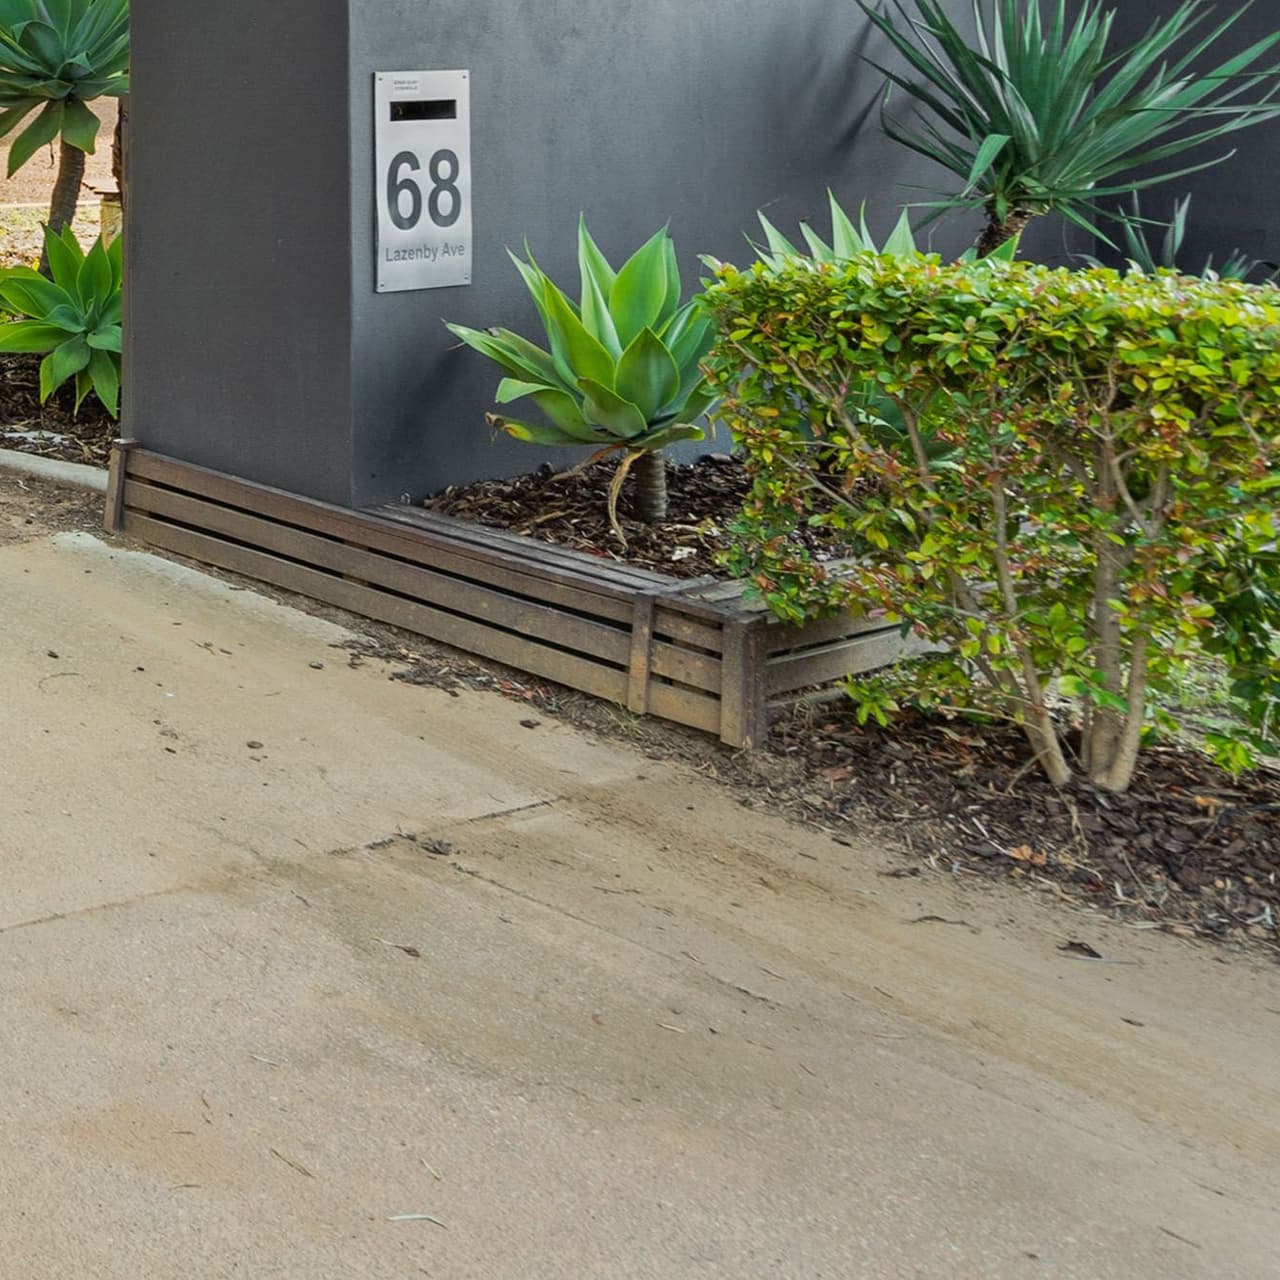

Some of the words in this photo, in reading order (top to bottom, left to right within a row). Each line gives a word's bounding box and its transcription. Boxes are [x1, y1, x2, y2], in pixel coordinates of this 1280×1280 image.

[386, 148, 462, 231] 68
[385, 244, 439, 263] Lazenby
[441, 242, 465, 257] Ave
